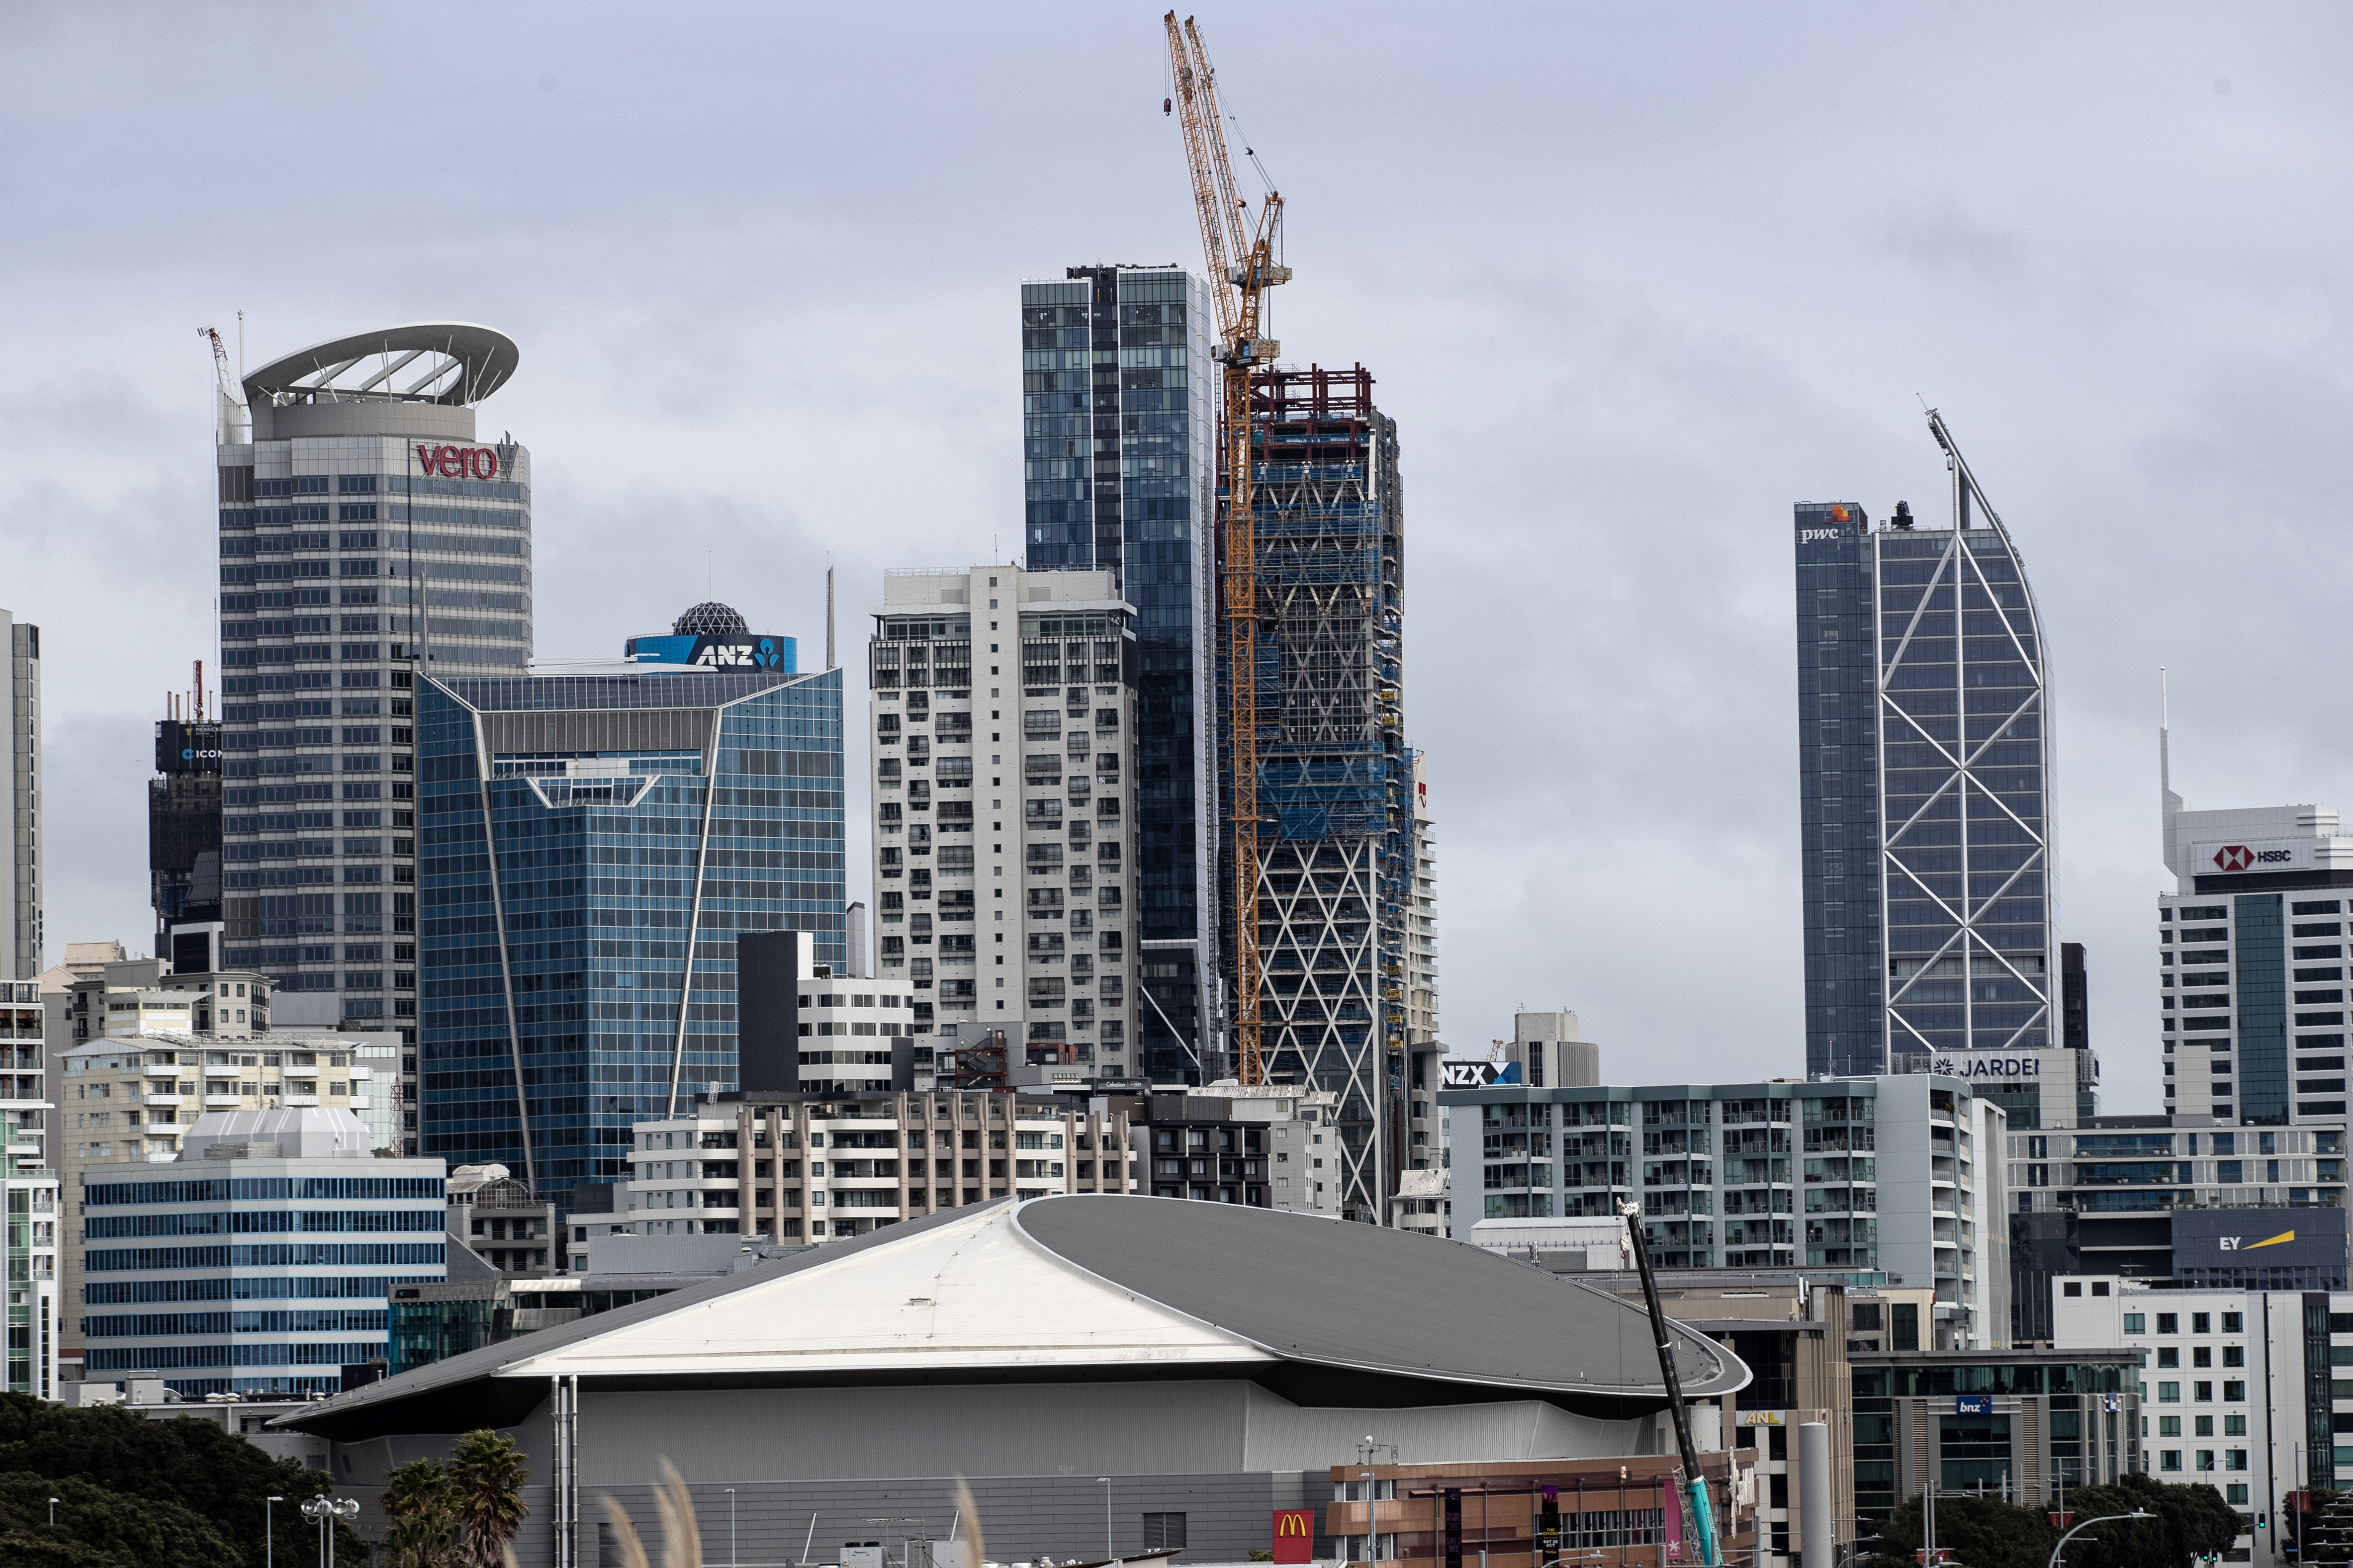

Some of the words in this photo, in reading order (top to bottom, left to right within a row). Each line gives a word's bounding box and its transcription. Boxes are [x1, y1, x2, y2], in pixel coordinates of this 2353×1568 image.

[419, 445, 497, 479] vero
[1801, 528, 1838, 544] pwc
[695, 645, 753, 666] ANZ
[2258, 850, 2291, 862] HSBC
[1443, 1065, 1487, 1084] NZX
[2220, 1237, 2241, 1250] EY
[1960, 1402, 1981, 1412] bnz
[1745, 1412, 1780, 1424] ANL
